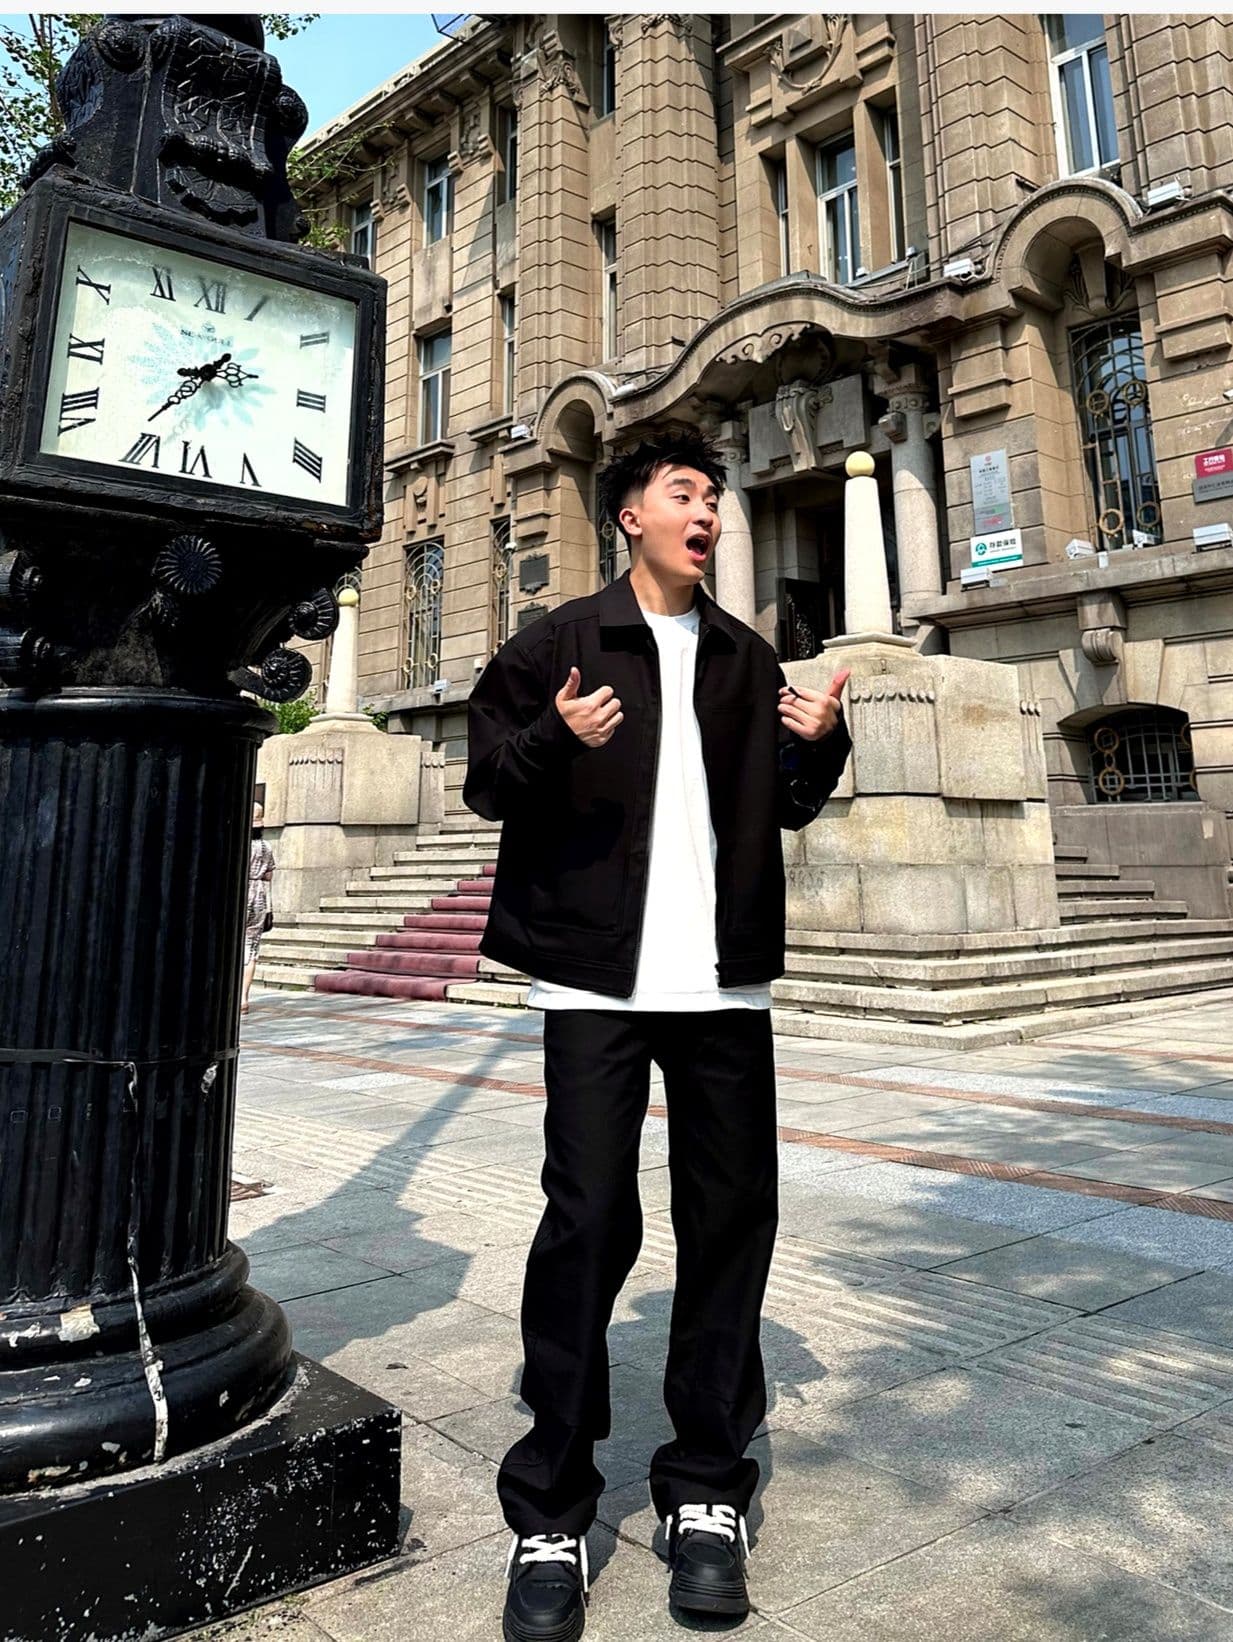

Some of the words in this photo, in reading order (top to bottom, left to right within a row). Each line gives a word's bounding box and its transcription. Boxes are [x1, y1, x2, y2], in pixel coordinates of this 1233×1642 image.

[76, 264, 111, 305] X
[150, 263, 176, 302] XI
[194, 278, 226, 315] XII
[67, 333, 105, 365] IX
[300, 331, 330, 349] II
[58, 387, 99, 437] VIII
[296, 388, 326, 413] III
[118, 432, 160, 469] VII
[178, 440, 213, 479] VI
[293, 437, 322, 483] IIII
[239, 452, 262, 487] V
